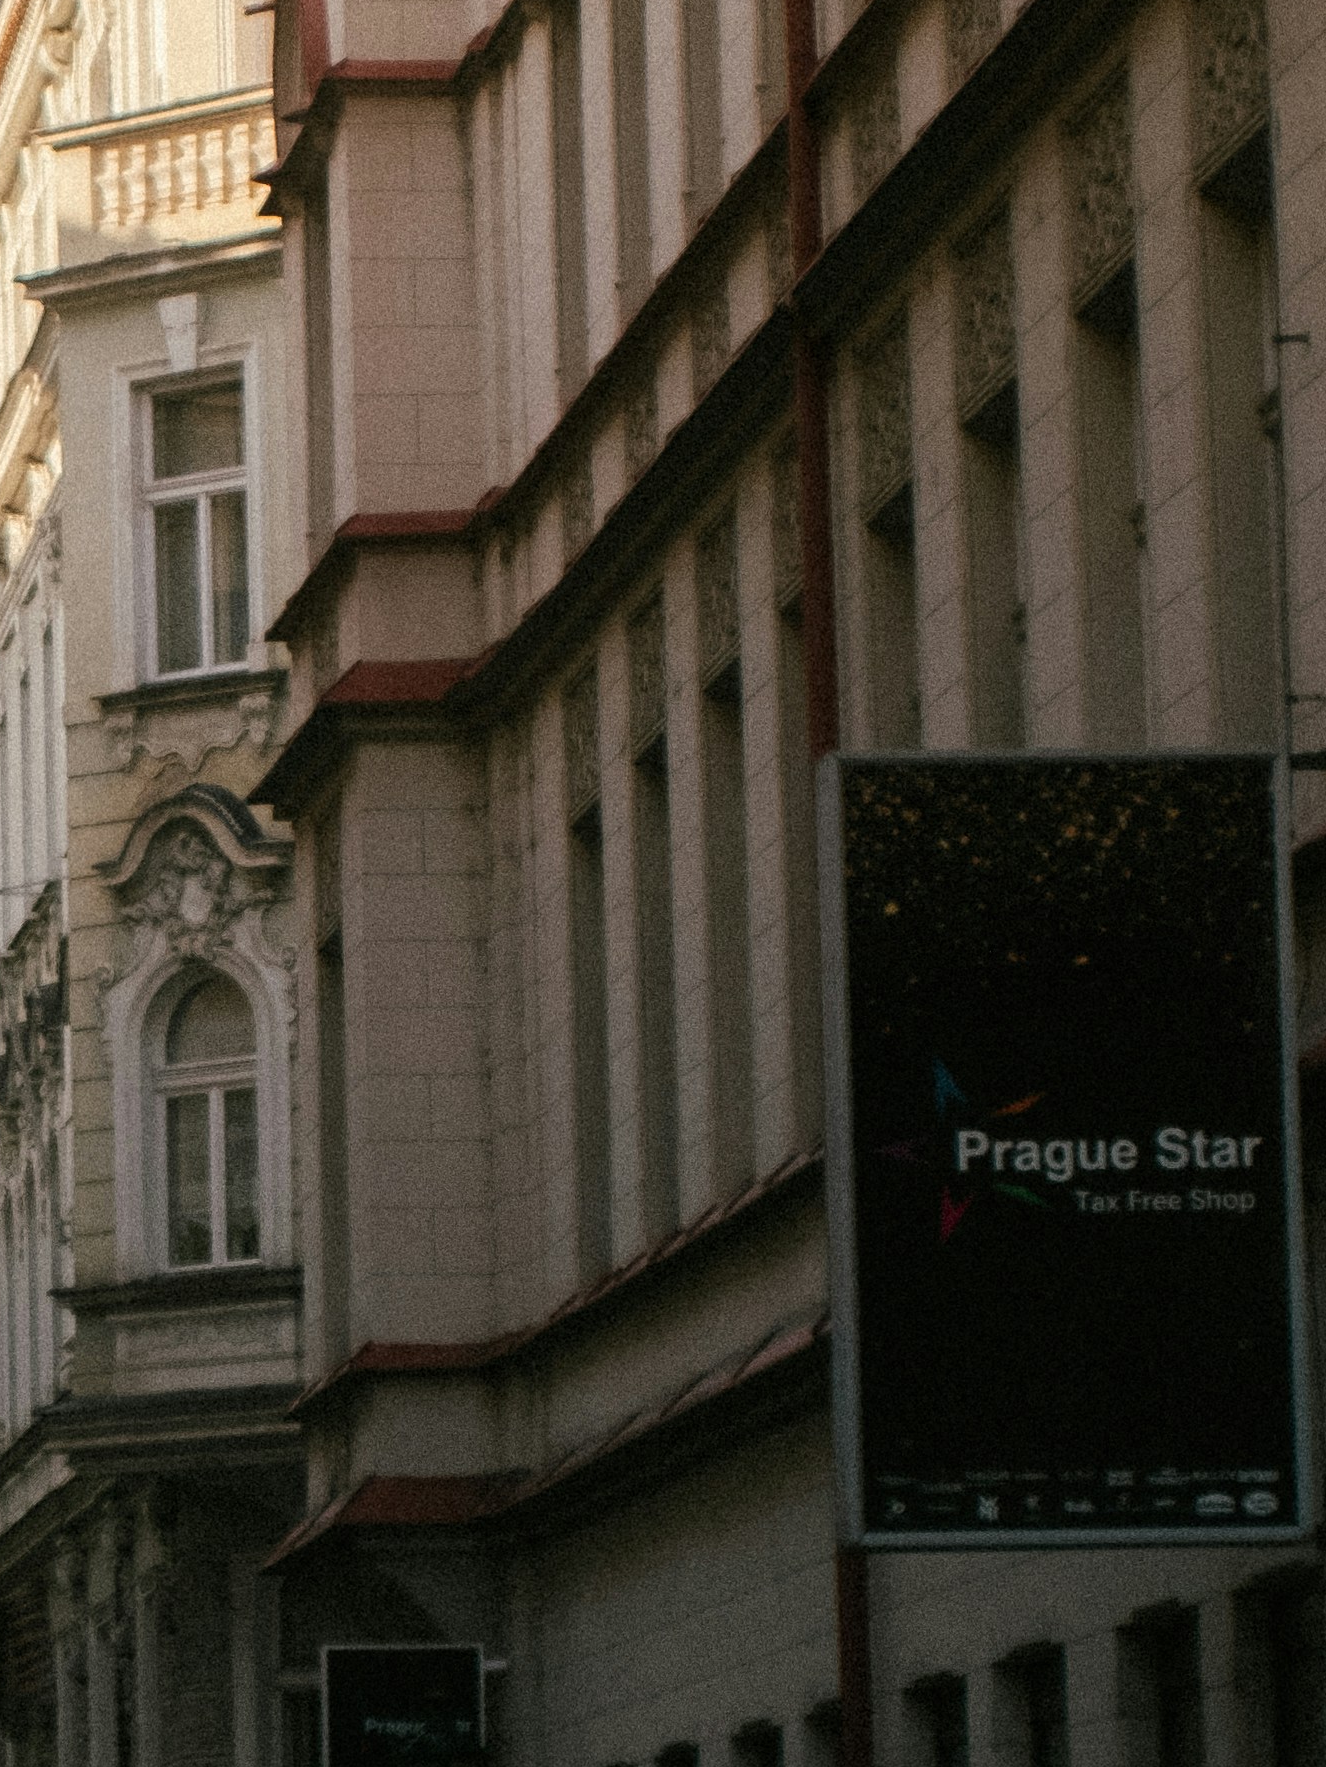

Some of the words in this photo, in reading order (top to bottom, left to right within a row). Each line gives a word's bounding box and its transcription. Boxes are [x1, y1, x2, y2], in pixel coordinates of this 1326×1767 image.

[955, 1128, 1139, 1182] Prague
[1156, 1126, 1263, 1170] Star
[1074, 1189, 1121, 1213] Tax
[1127, 1189, 1182, 1212] Free
[1189, 1187, 1256, 1215] Shop
